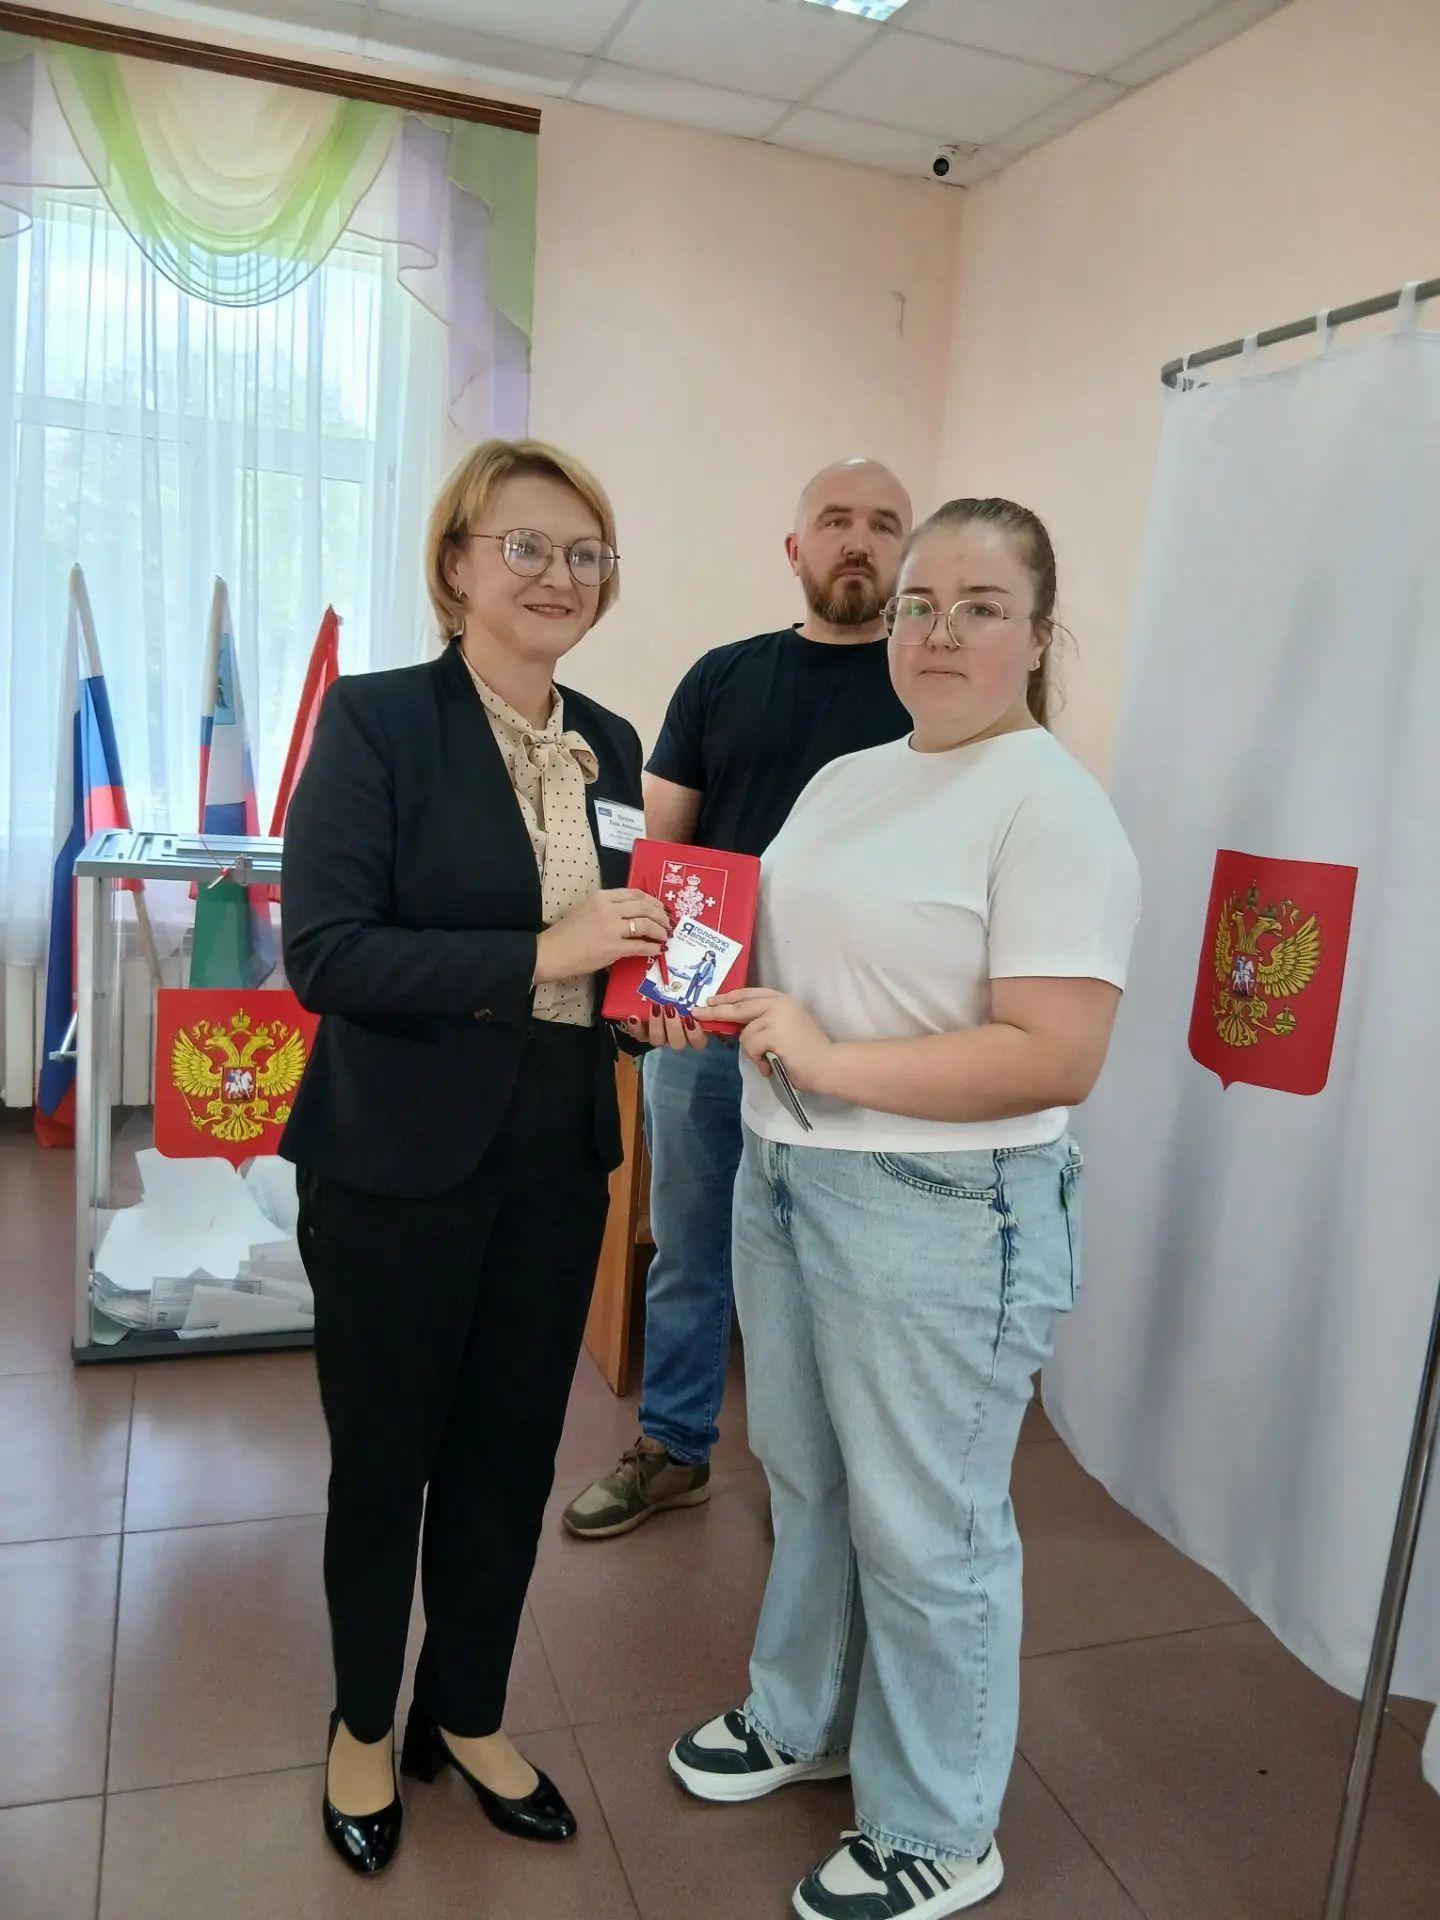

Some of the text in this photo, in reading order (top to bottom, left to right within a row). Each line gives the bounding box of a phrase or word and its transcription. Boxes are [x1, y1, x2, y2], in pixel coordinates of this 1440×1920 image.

[681, 922, 695, 935] Я
[693, 925, 730, 948] ГОЛОСУЮ
[690, 932, 727, 953] ВПЕРВЫЕ
